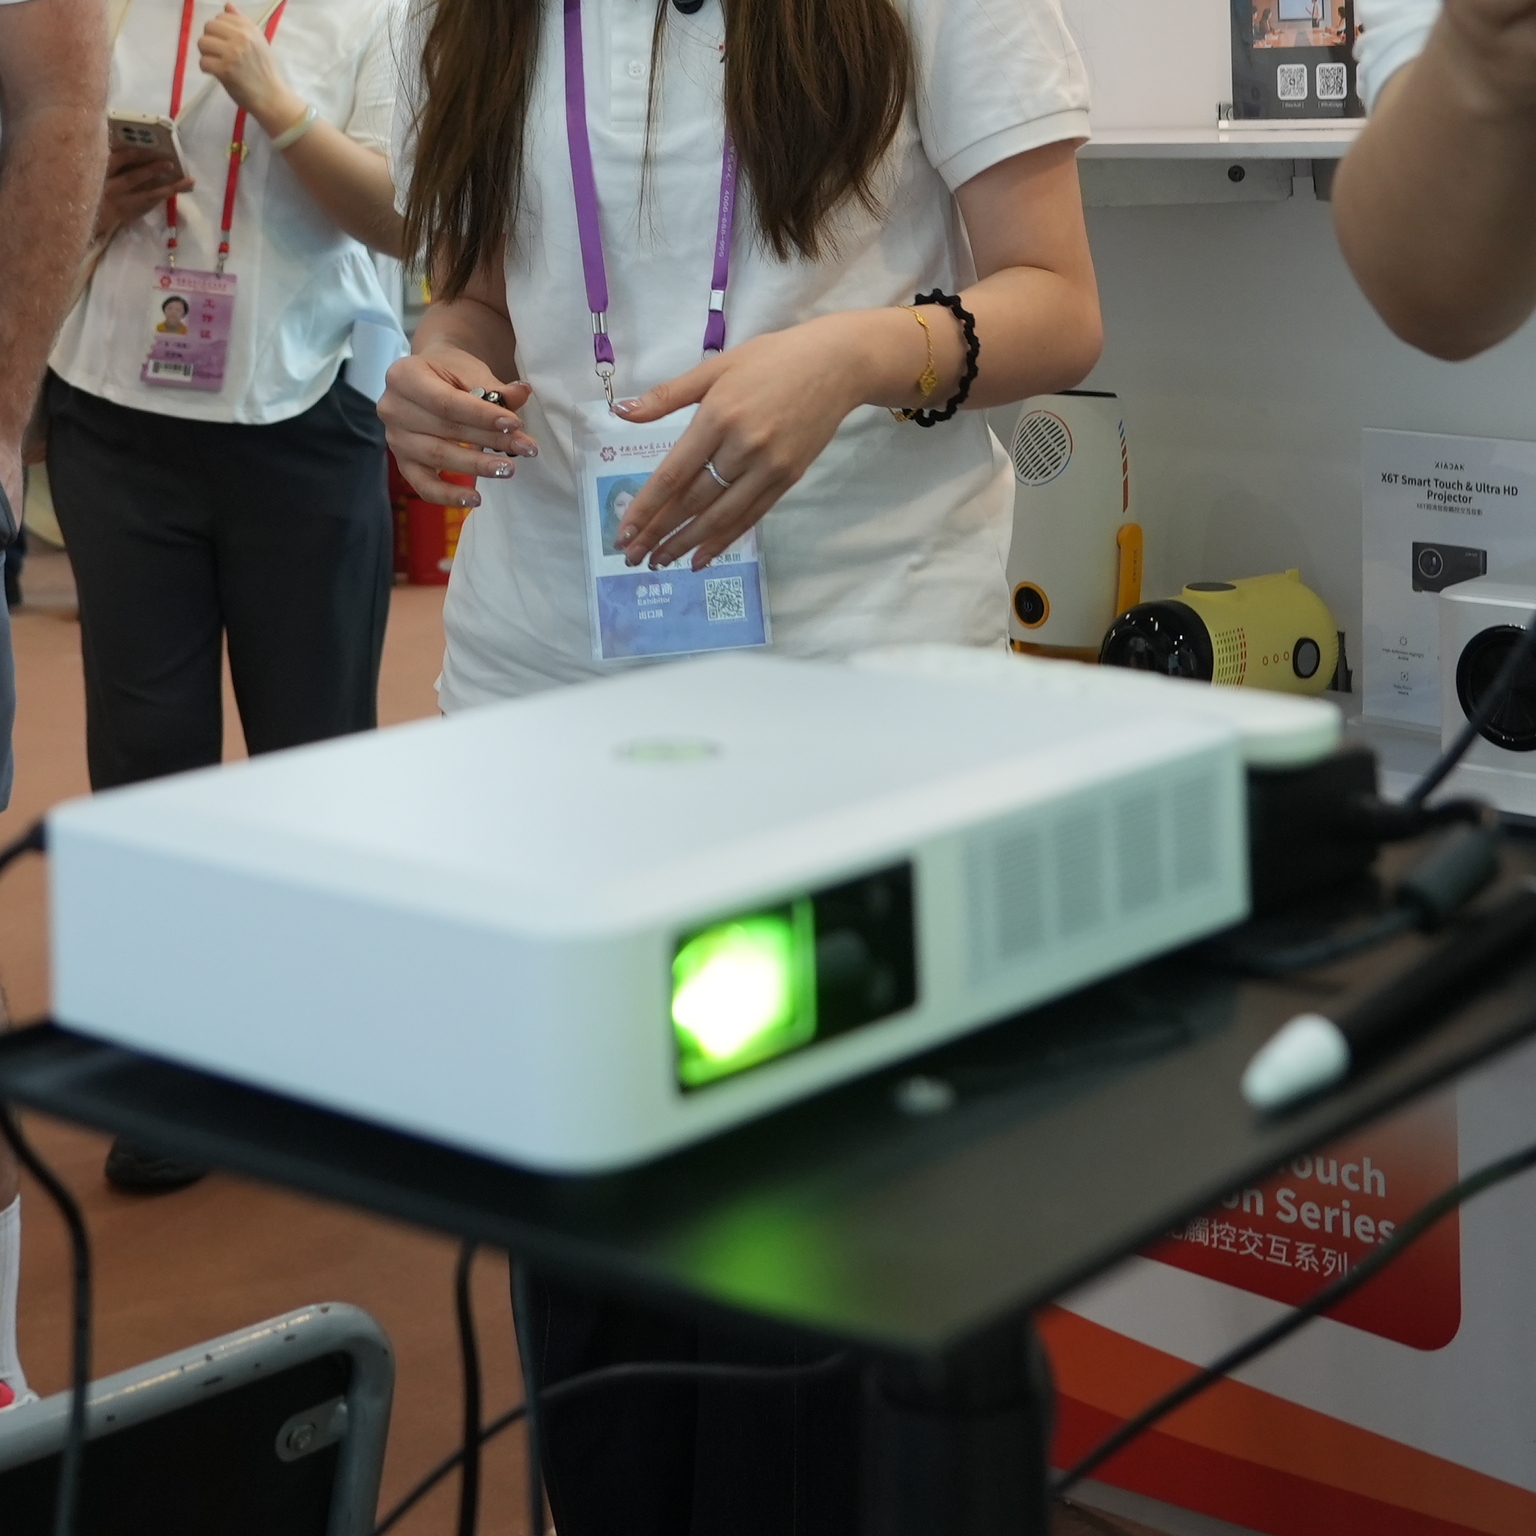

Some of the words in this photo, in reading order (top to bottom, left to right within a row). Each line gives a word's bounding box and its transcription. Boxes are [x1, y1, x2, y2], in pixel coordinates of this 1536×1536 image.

[1381, 472, 1399, 484] X6T
[1401, 475, 1431, 488] Smart
[1434, 478, 1463, 492] Touch
[1465, 481, 1473, 492] &
[1475, 482, 1501, 495] Ultra
[1503, 485, 1519, 497] HD
[1427, 489, 1473, 505] Projector
[637, 596, 670, 606] Exhibitor
[1276, 1187, 1396, 1245] Series
